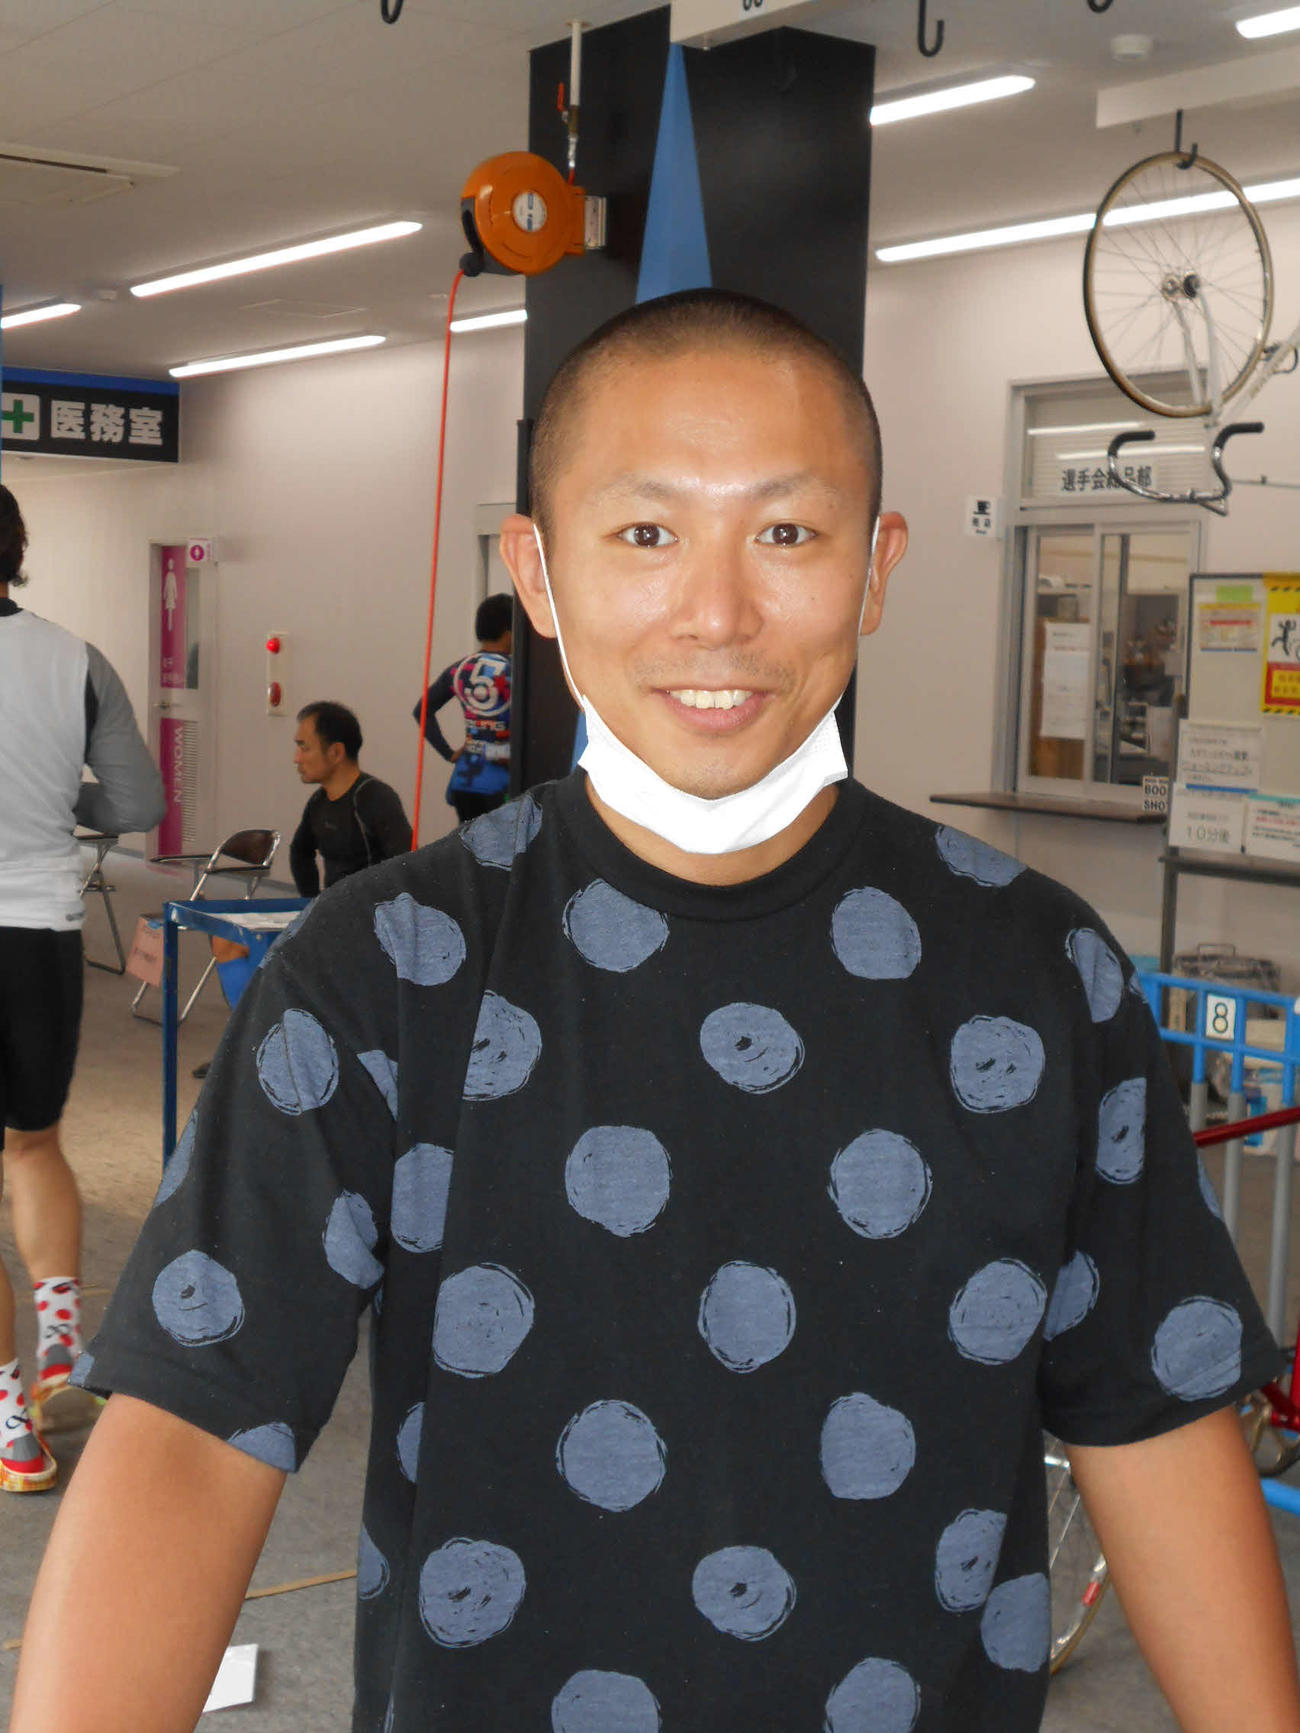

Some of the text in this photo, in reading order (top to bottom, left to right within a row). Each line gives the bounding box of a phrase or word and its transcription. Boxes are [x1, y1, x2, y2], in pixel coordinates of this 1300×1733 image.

[51, 399, 163, 446] 医務室
[464, 656, 506, 710] 5
[1144, 800, 1168, 811] SHO
[1213, 1002, 1229, 1034] 8
